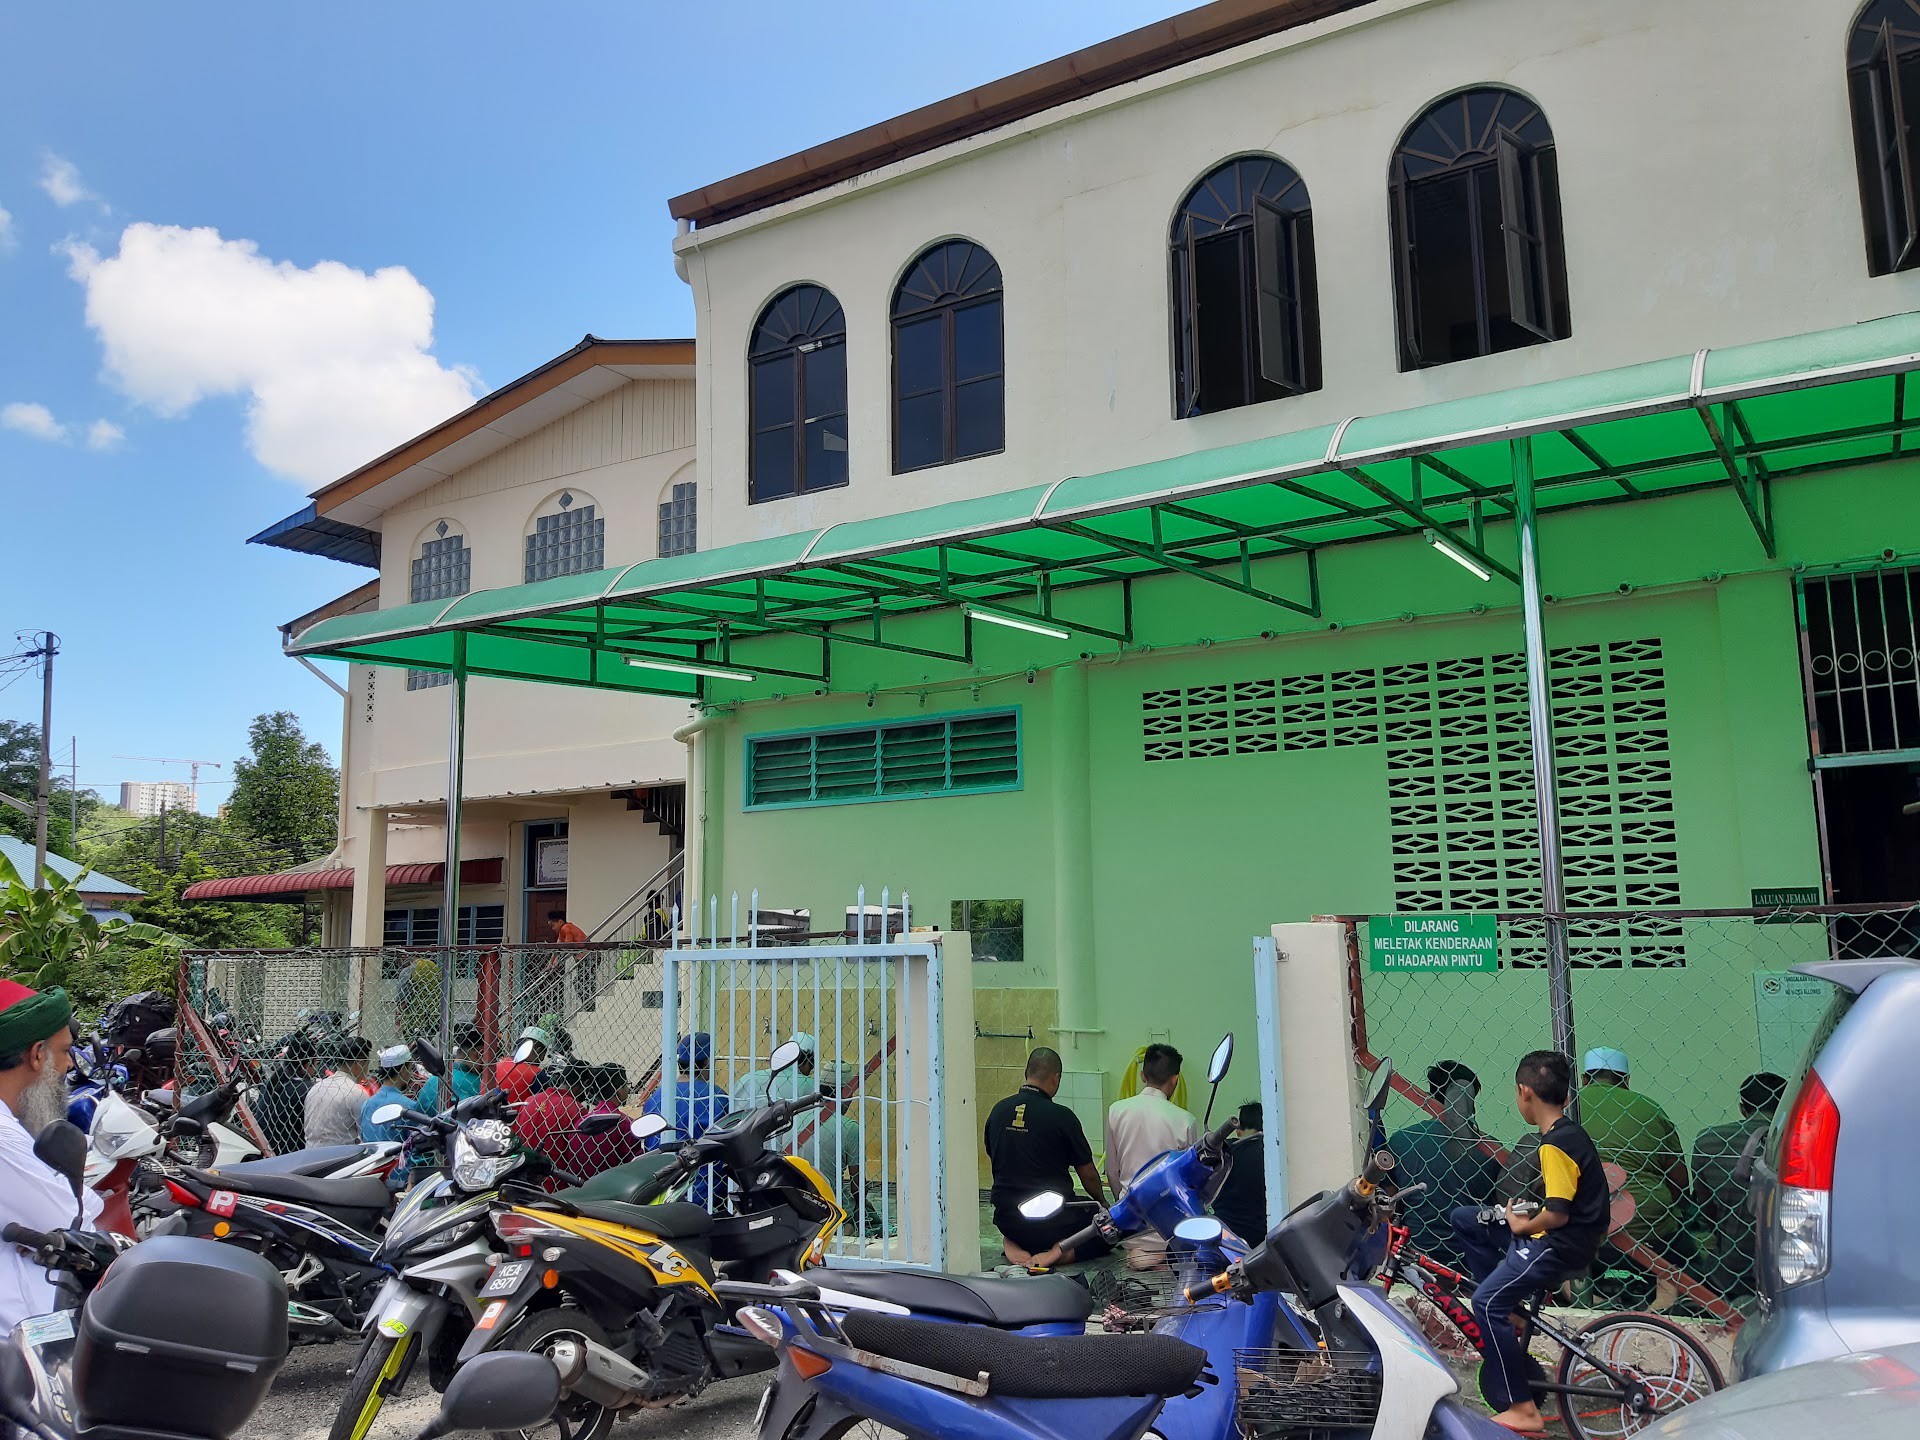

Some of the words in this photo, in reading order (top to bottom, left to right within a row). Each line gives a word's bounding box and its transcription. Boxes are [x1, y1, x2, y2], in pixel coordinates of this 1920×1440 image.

[1404, 919, 1459, 933] DILARANG
[1374, 937, 1422, 950] MELETAK
[1425, 936, 1493, 950] KENDERAAN
[1384, 954, 1395, 967] DI
[1397, 954, 1448, 967] HADAPAN
[1451, 953, 1483, 967] PINTU
[1012, 1103, 1027, 1128] 1
[482, 1119, 511, 1136] PNG
[210, 1190, 235, 1210] P
[499, 1264, 523, 1278] KEA
[489, 1276, 518, 1291] 8971
[476, 1302, 502, 1328] P
